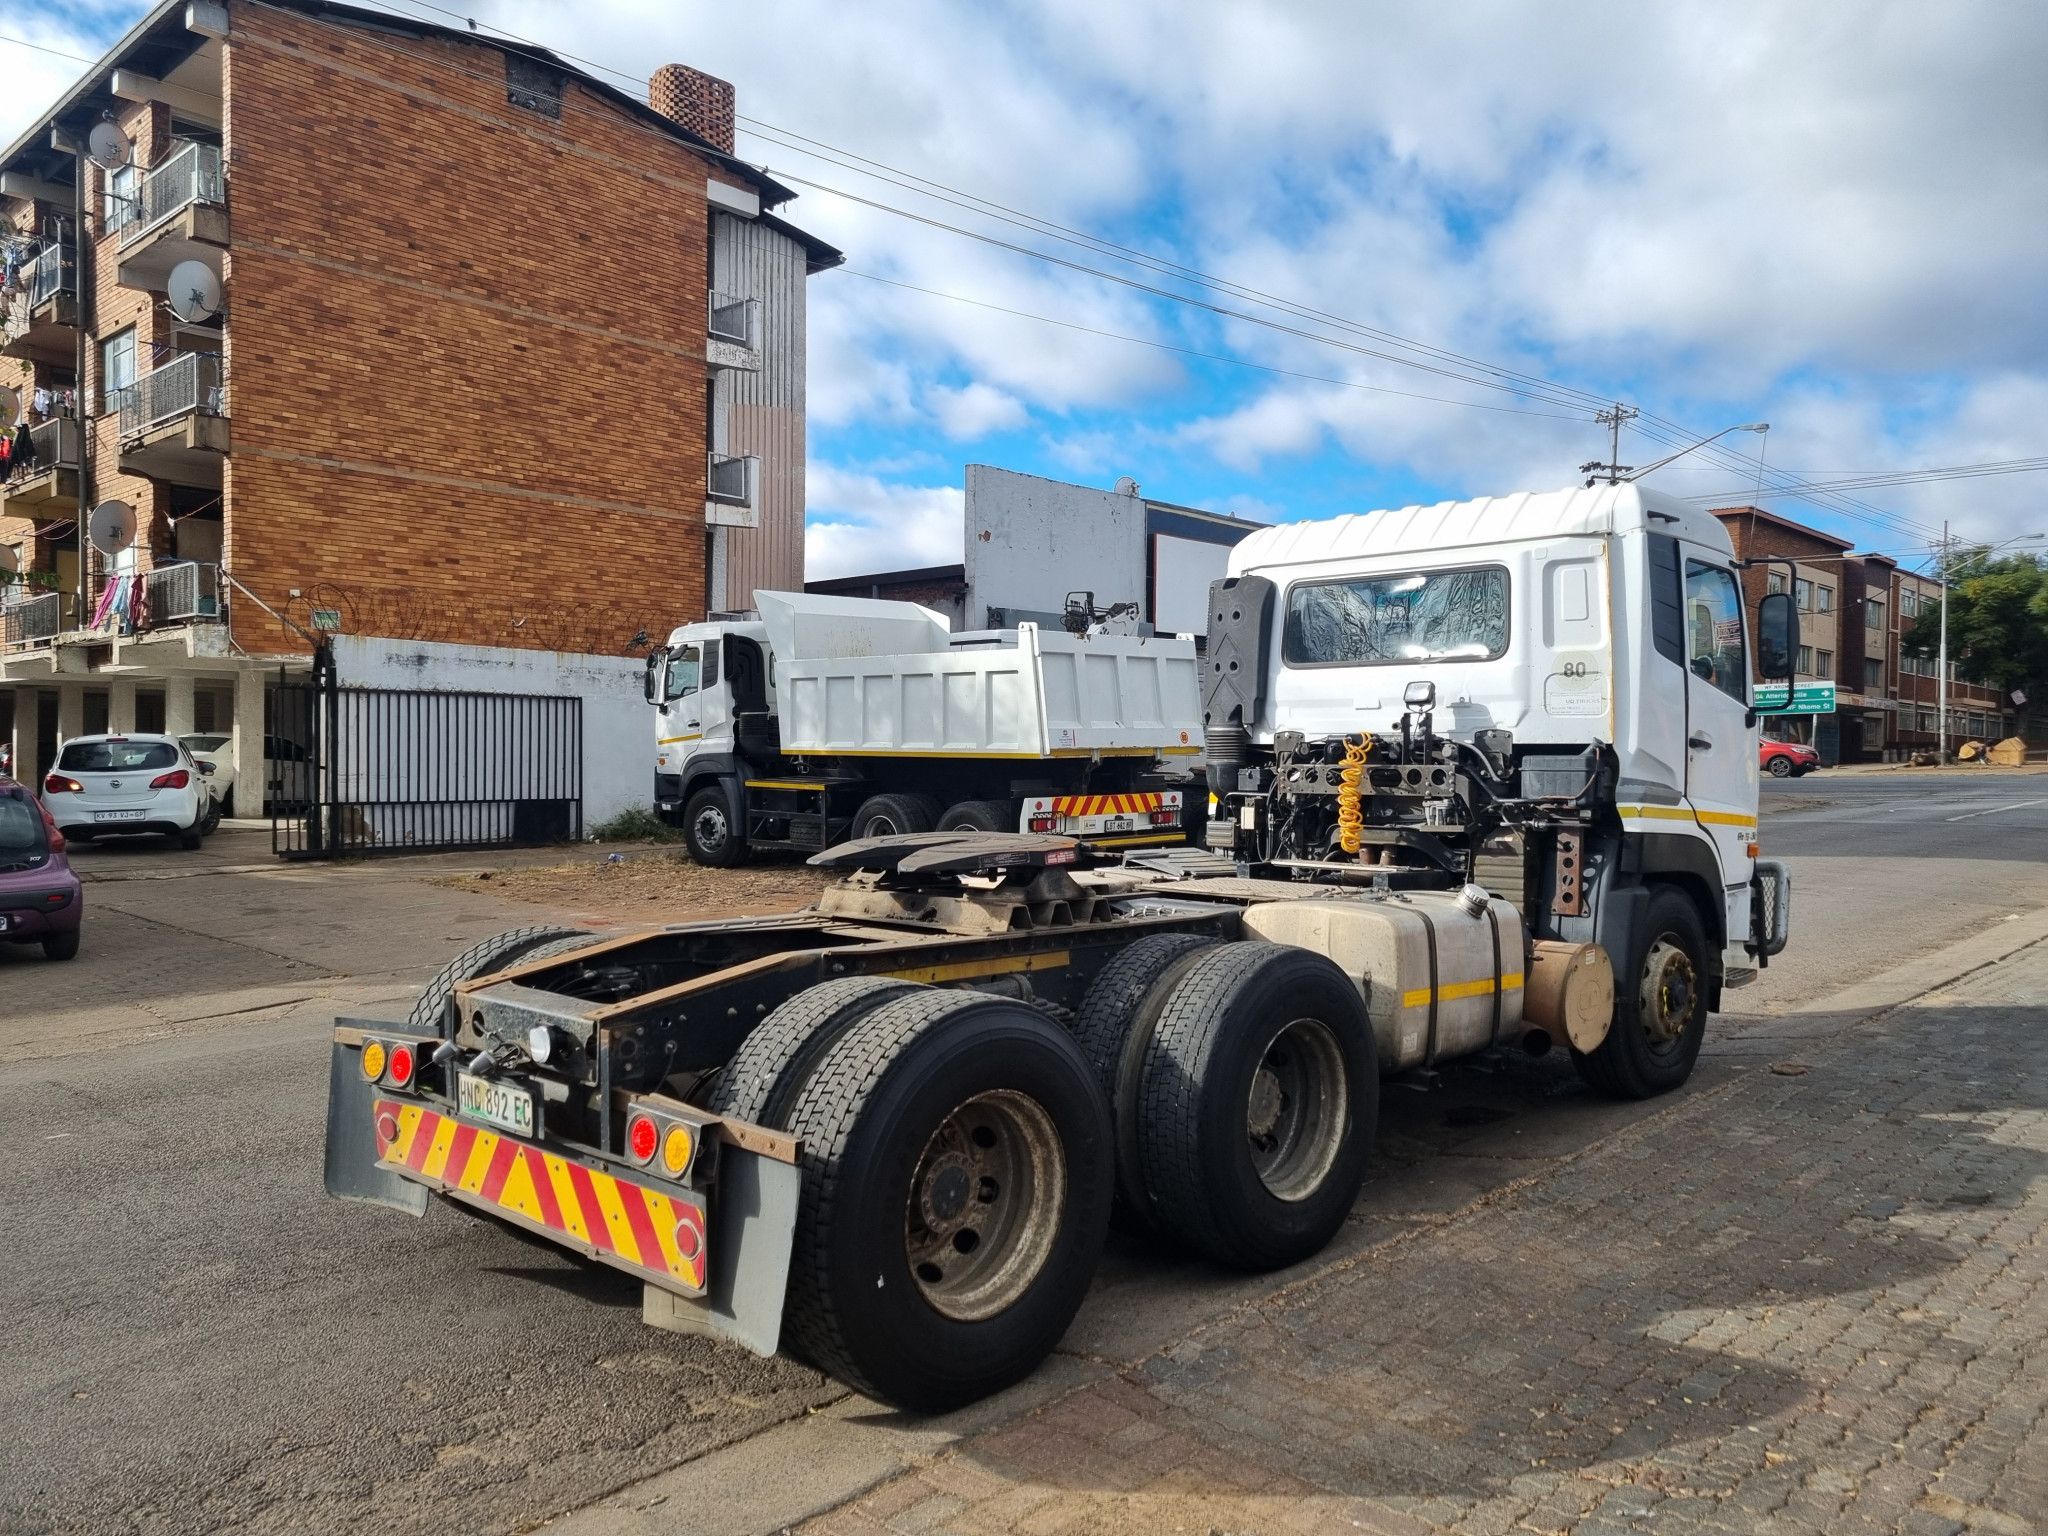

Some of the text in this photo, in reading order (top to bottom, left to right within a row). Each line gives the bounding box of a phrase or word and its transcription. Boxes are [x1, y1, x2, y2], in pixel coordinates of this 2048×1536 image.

[1564, 662, 1586, 678] 80
[1765, 691, 1807, 700] Atteridville
[460, 1080, 531, 1127] HNC 892 EC
